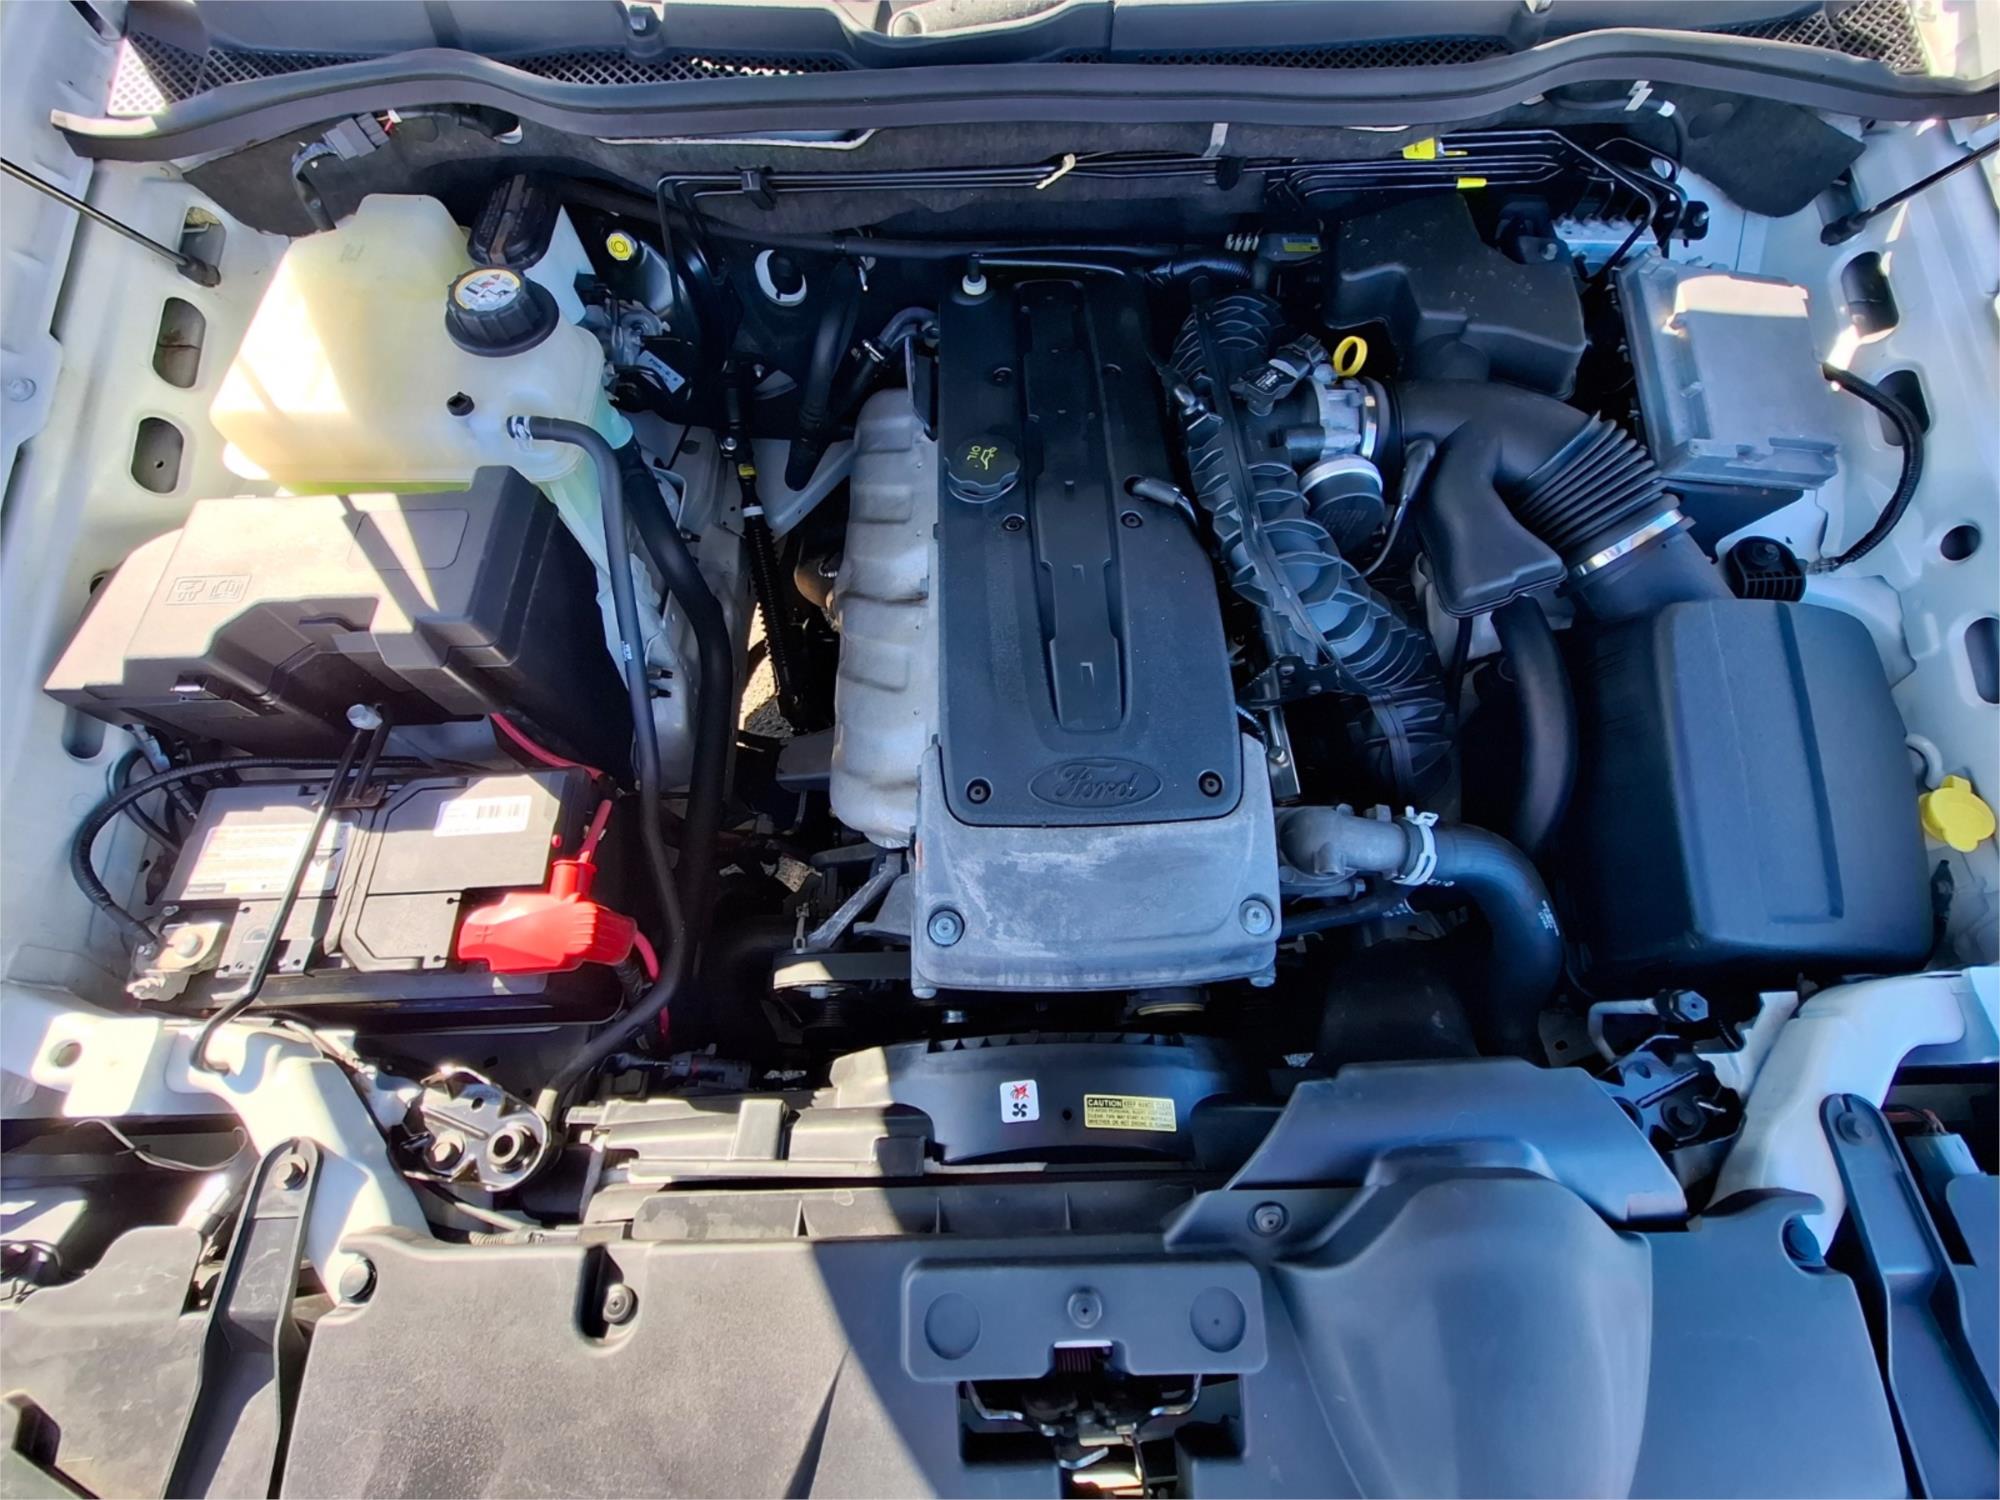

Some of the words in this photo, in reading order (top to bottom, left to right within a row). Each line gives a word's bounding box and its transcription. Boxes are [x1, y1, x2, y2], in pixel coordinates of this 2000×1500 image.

[967, 445, 981, 460] OIL
[1053, 762, 1140, 801] Ford
[1088, 1099, 1122, 1107] CAUTION
